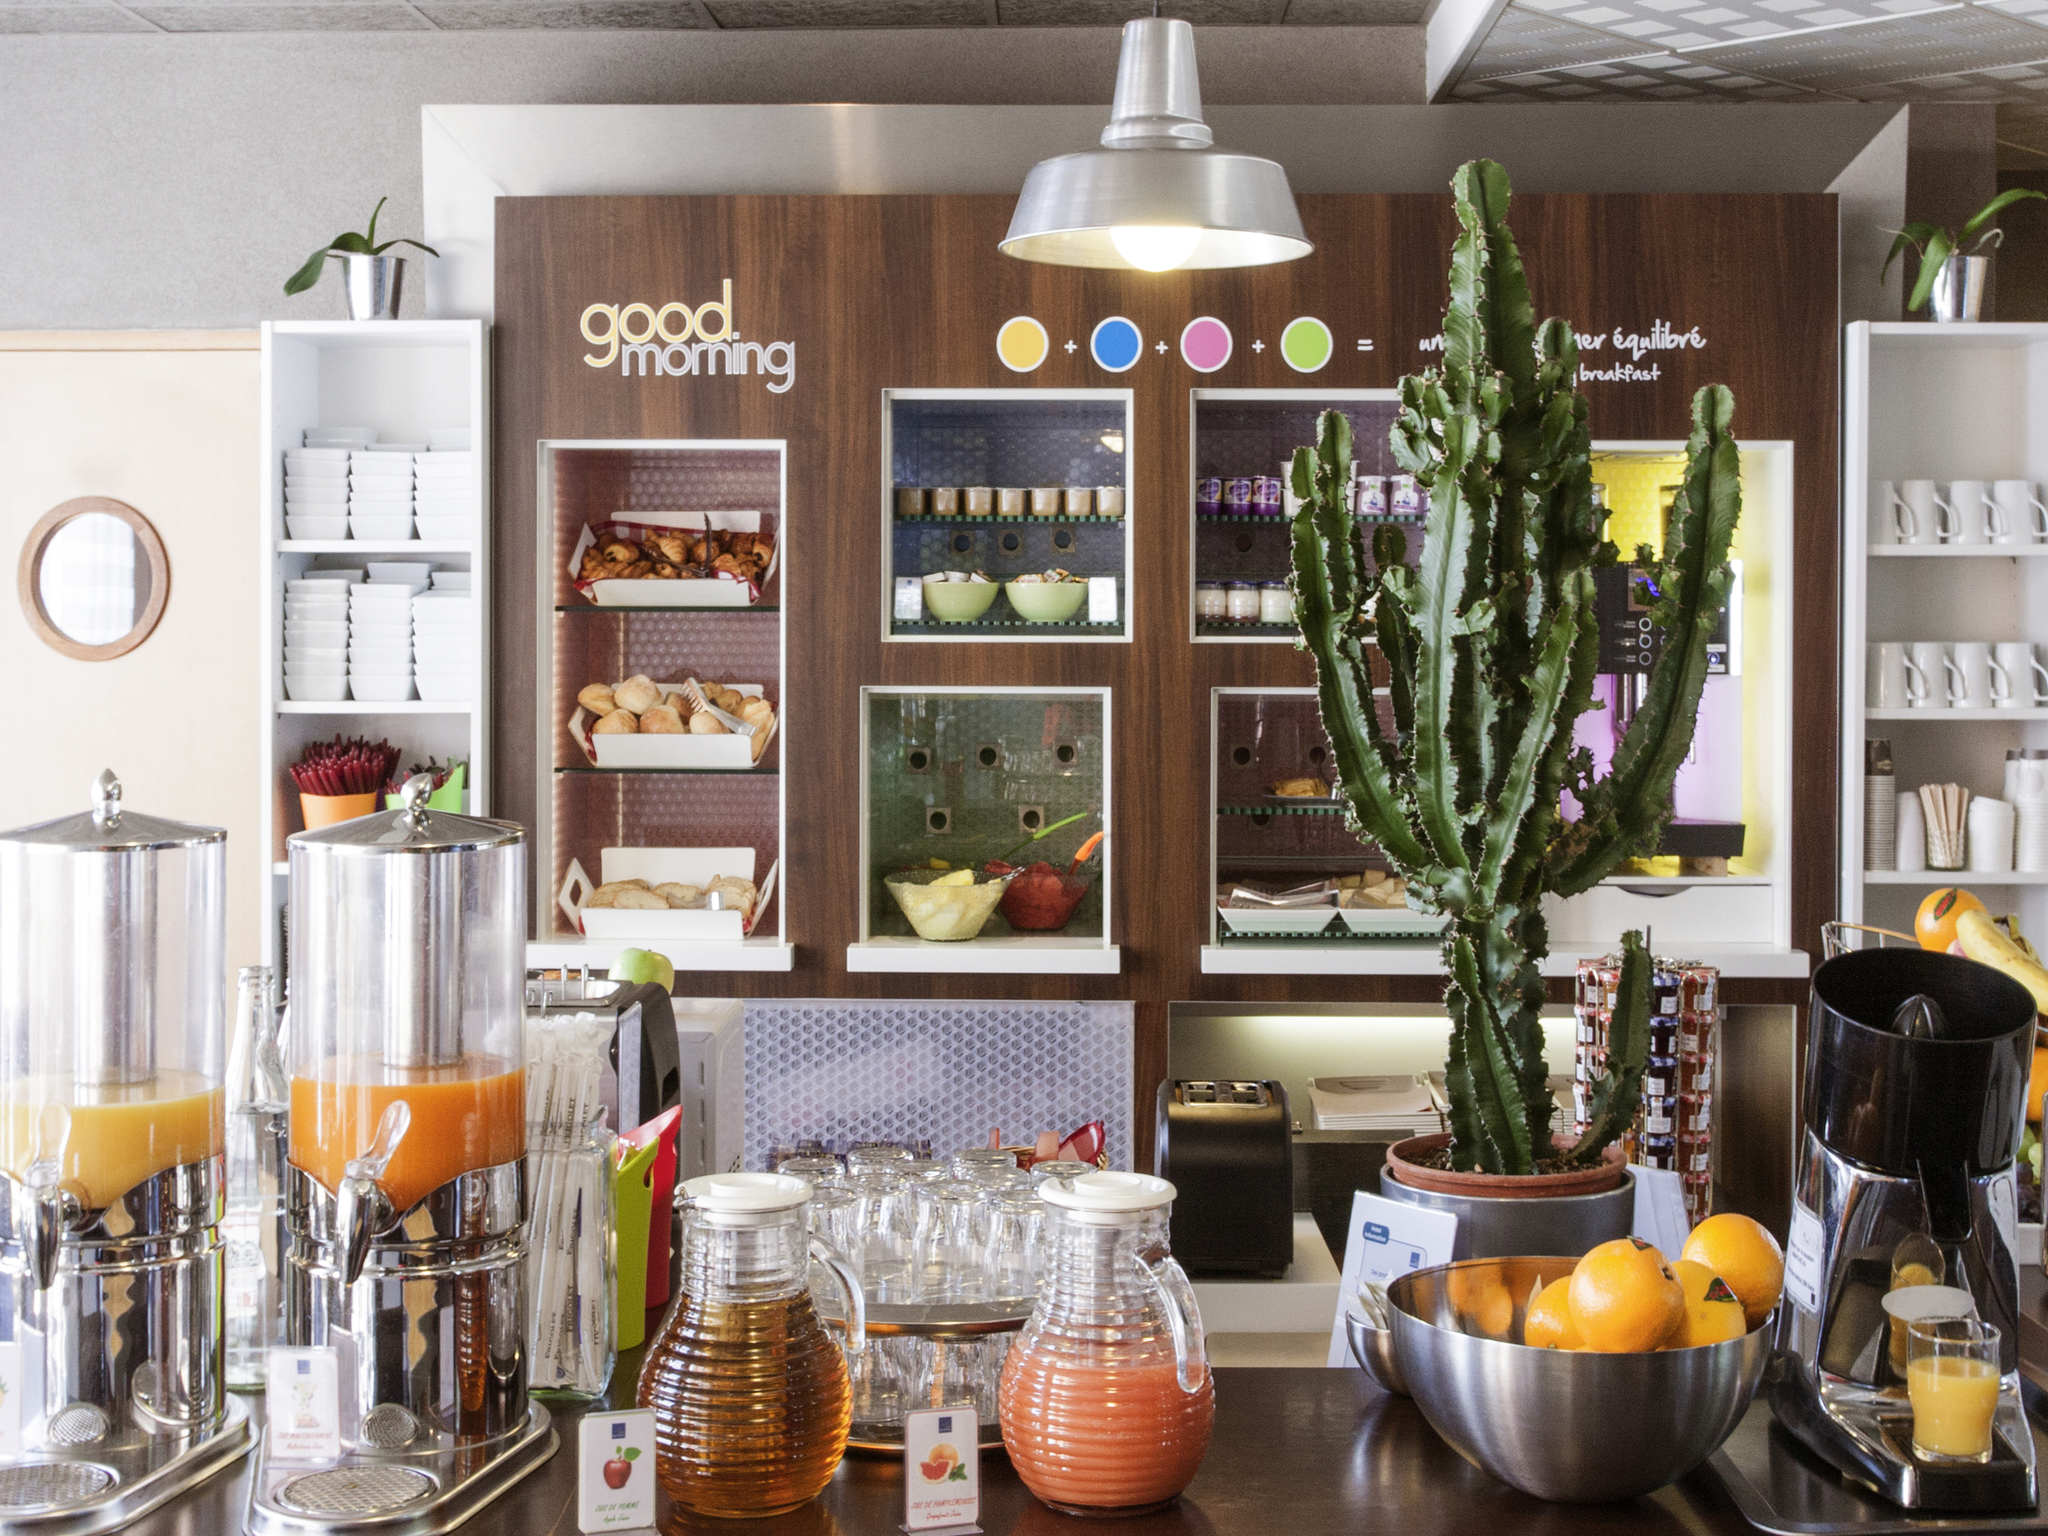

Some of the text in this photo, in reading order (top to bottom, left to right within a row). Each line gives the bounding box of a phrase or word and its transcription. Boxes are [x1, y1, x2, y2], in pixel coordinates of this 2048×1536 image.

[580, 278, 732, 368] good
[1419, 334, 1445, 351] un
[1612, 318, 1708, 362] équilibré
[621, 331, 796, 394] morning
[1579, 361, 1662, 383] breakfast
